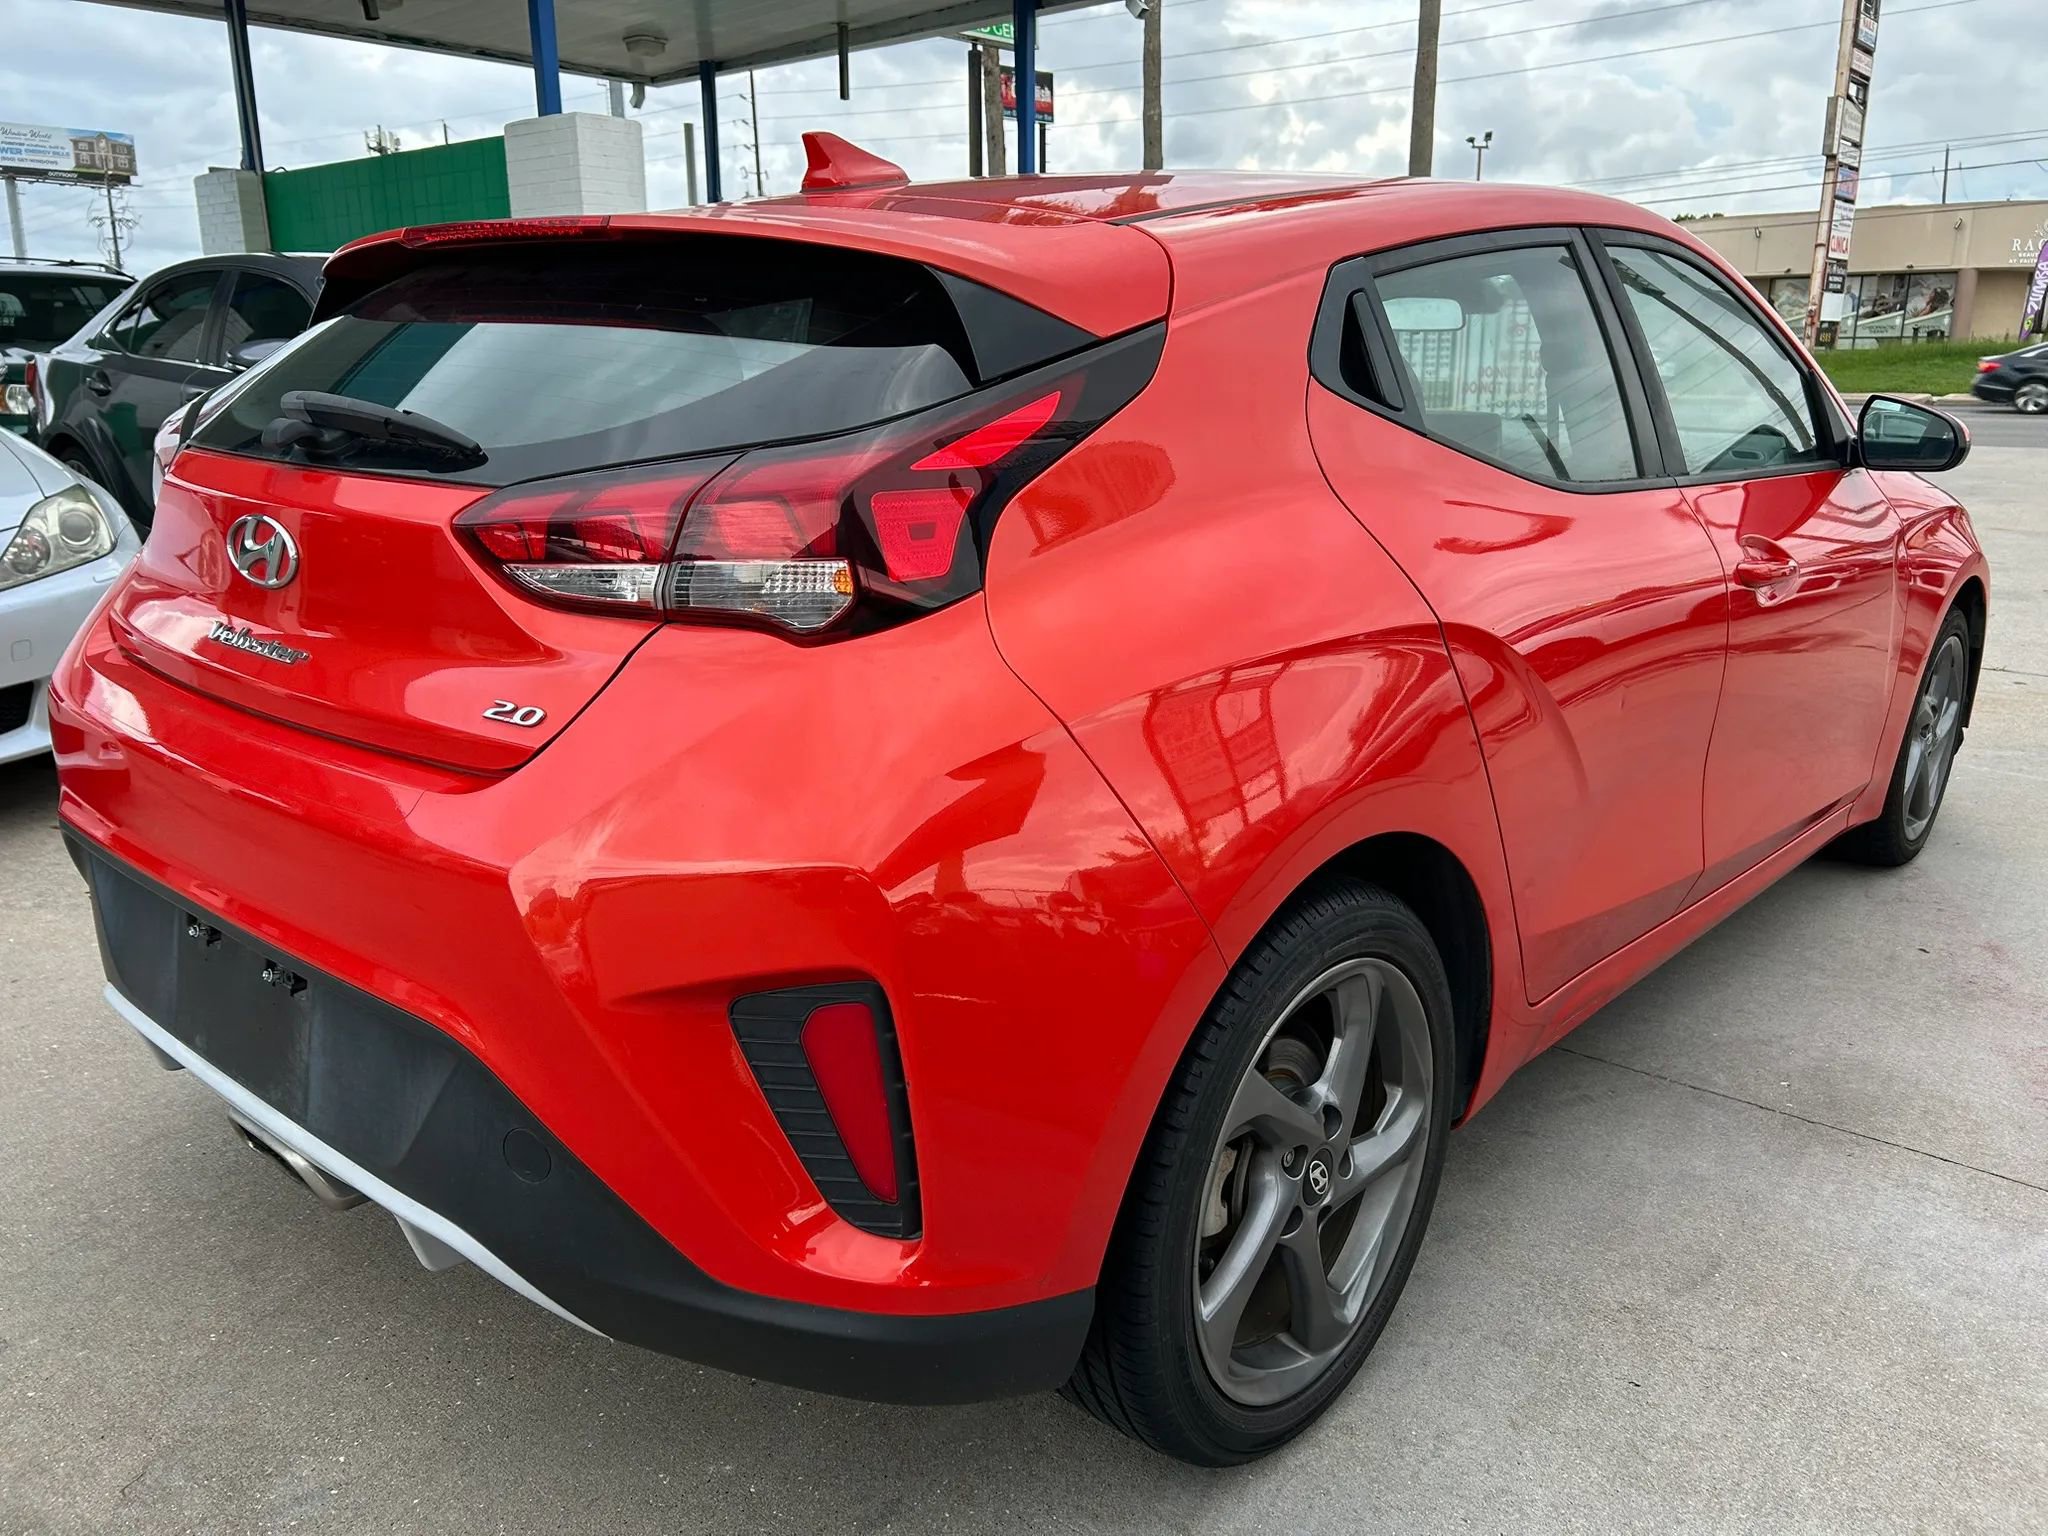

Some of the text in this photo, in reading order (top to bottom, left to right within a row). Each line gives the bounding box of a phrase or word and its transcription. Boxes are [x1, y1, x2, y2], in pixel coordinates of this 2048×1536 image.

[0, 126, 28, 137] Window
[29, 129, 52, 140] World
[1831, 235, 1849, 254] CLINICA
[2027, 261, 2048, 314] ZUMBA
[208, 620, 312, 664] Veloster
